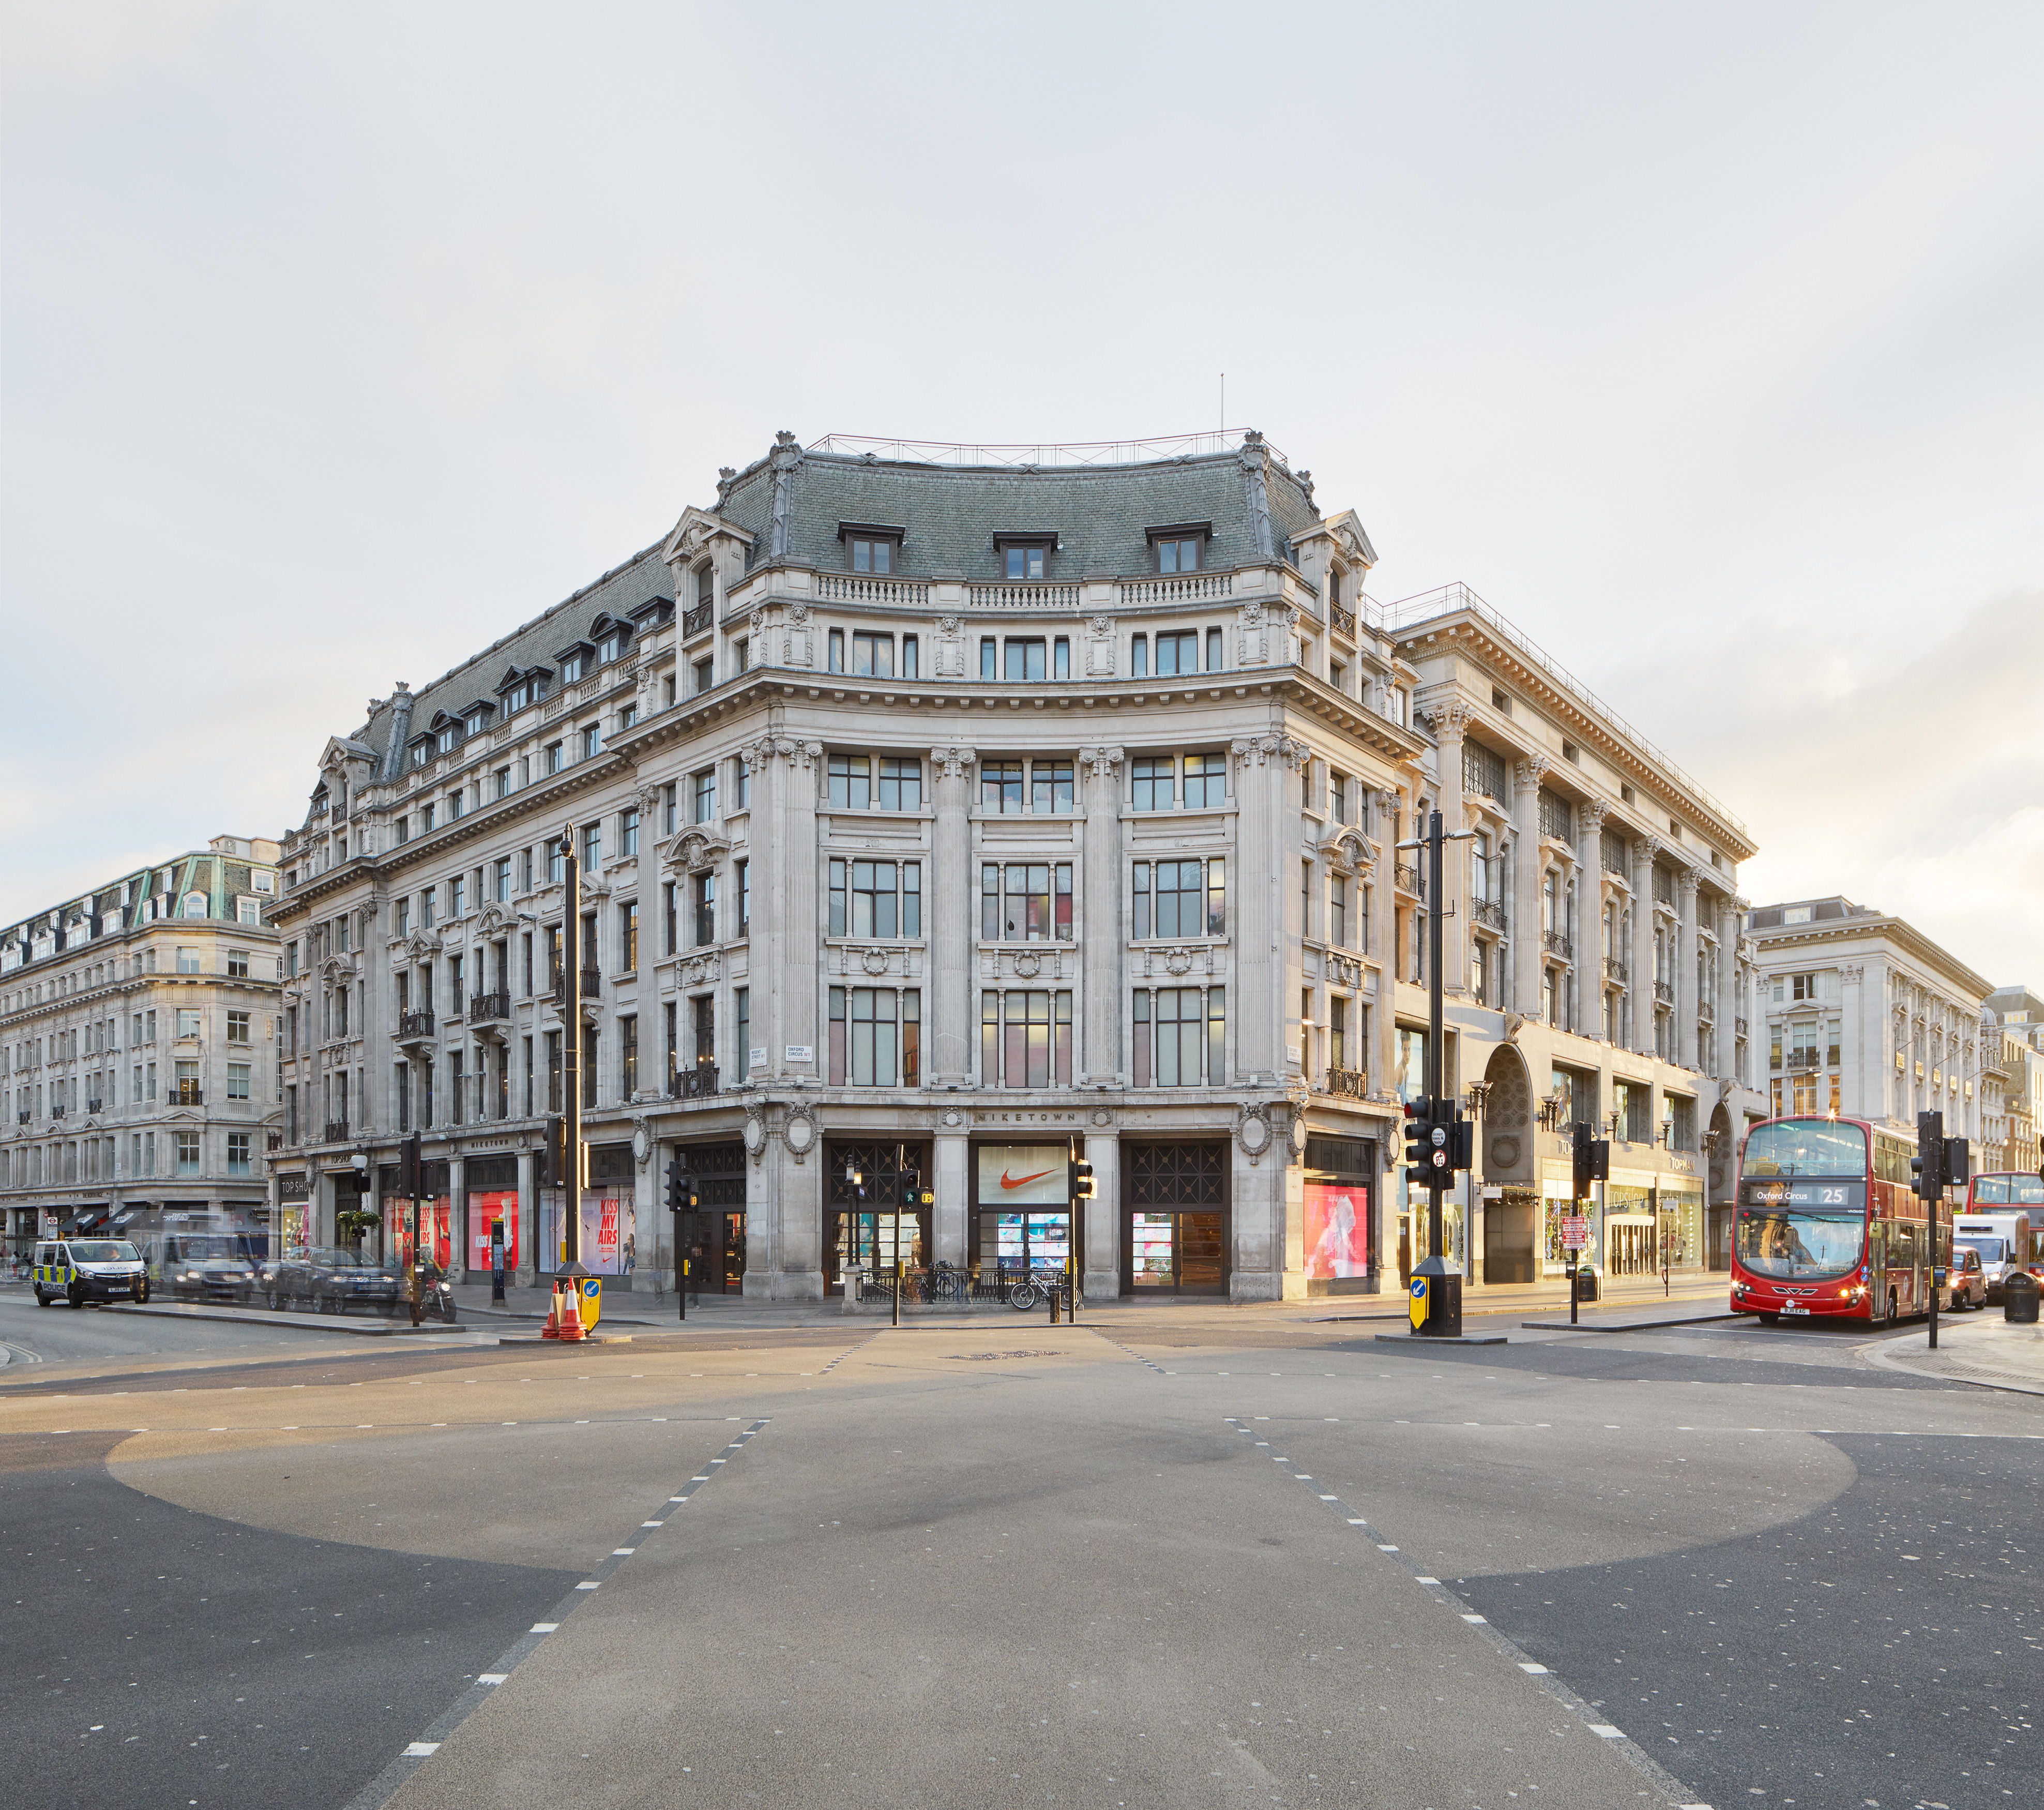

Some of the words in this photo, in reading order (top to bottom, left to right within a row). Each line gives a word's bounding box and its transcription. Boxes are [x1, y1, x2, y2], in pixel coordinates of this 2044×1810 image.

[978, 1113, 1076, 1122] NIKETOWN
[471, 1139, 508, 1148] NIKETOWN
[331, 1154, 352, 1164] TOPSHOP
[1671, 1156, 1695, 1172] TOPMAN
[1609, 1191, 1644, 1209] TOPSHOP
[1757, 1191, 1783, 1200] Oxford
[1823, 1189, 1843, 1203] 25
[600, 1199, 618, 1214] KISS
[601, 1214, 616, 1229] MY
[419, 1231, 430, 1244] IRS
[475, 1235, 488, 1248] KISS
[597, 1229, 617, 1245] AIRS
[43, 1283, 66, 1292] POLICE
